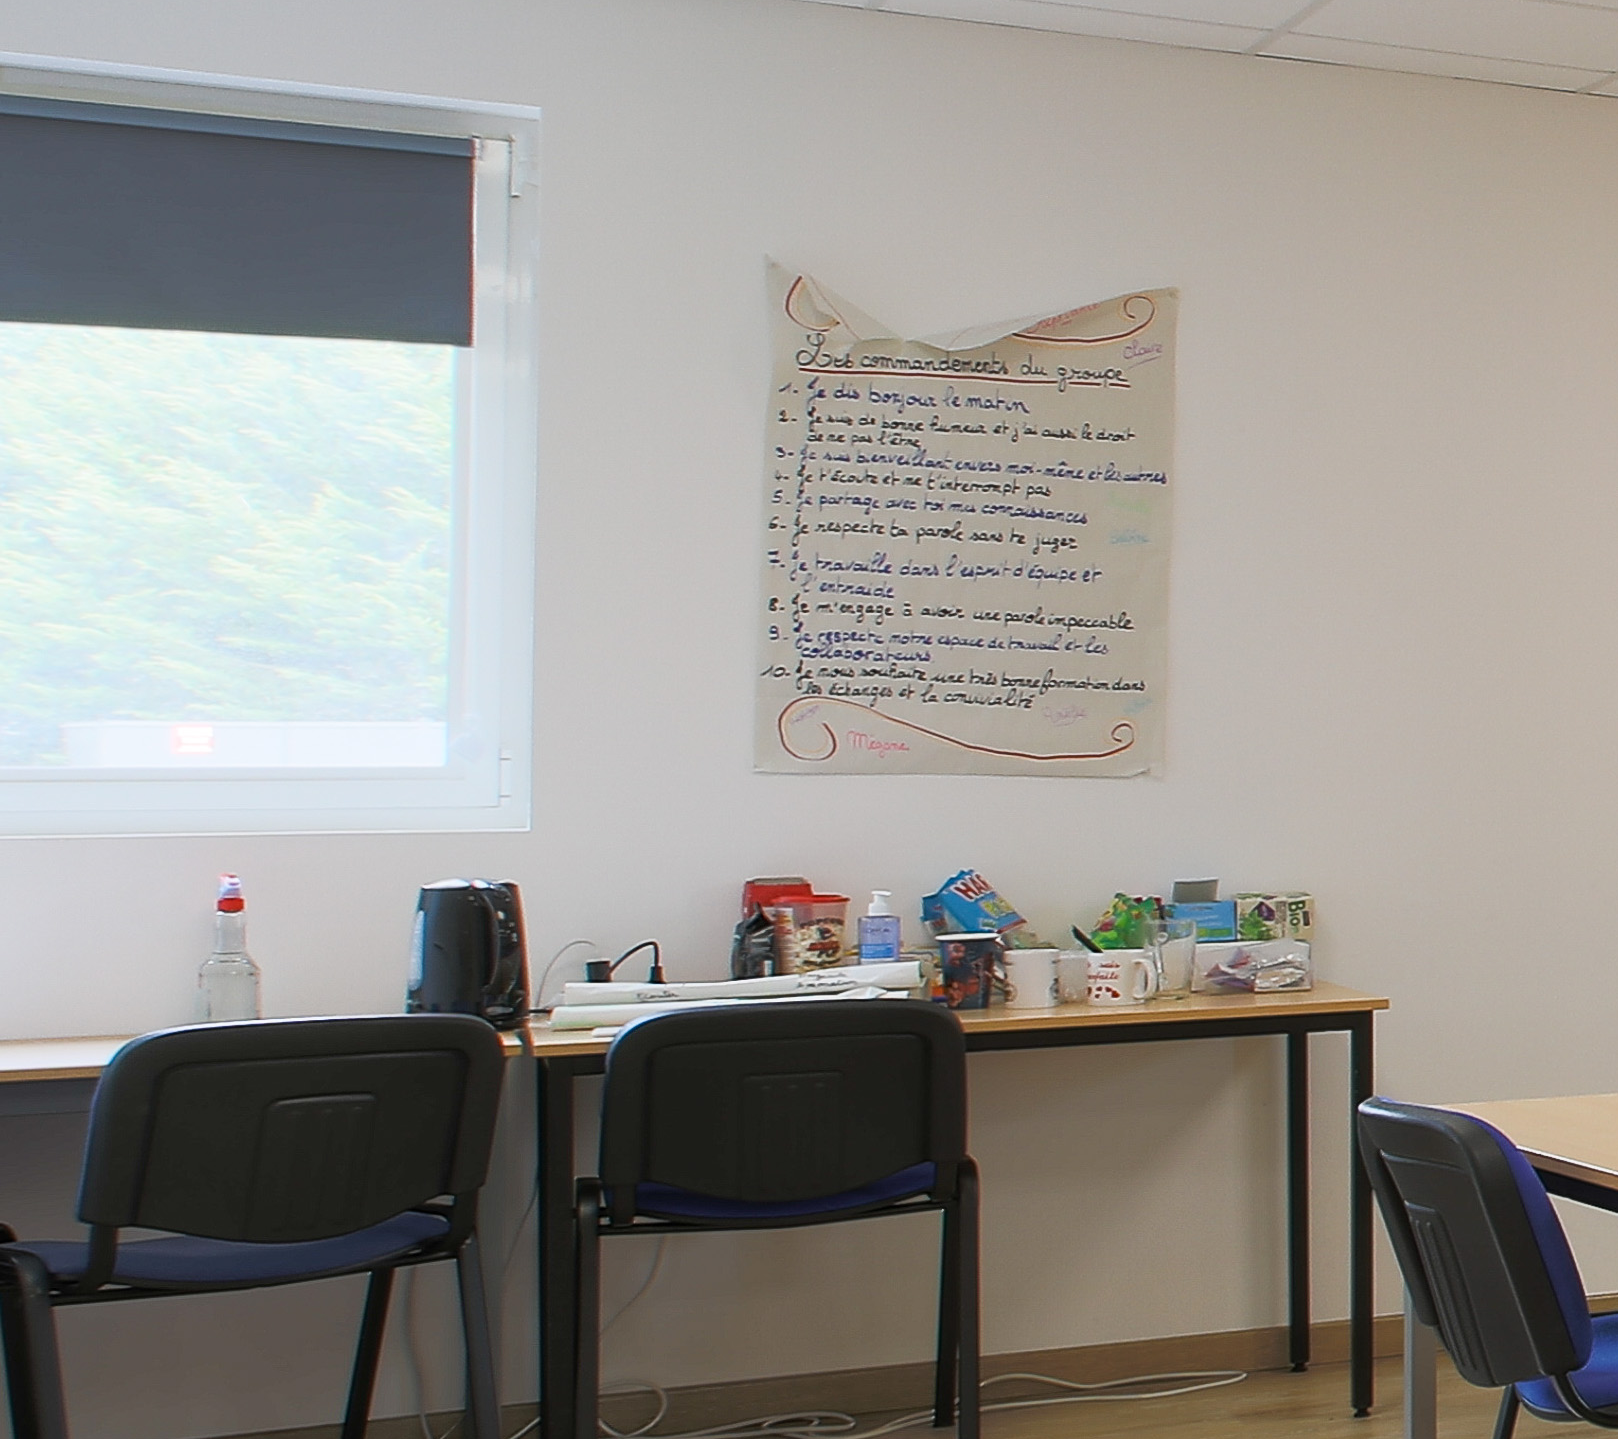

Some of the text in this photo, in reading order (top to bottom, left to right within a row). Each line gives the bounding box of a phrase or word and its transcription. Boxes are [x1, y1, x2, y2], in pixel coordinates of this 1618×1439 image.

[796, 333, 1129, 391] Les commandements du groupe
[832, 382, 860, 400] dis
[868, 382, 938, 414] bonjour
[943, 385, 963, 407] le
[968, 393, 1029, 414] matin
